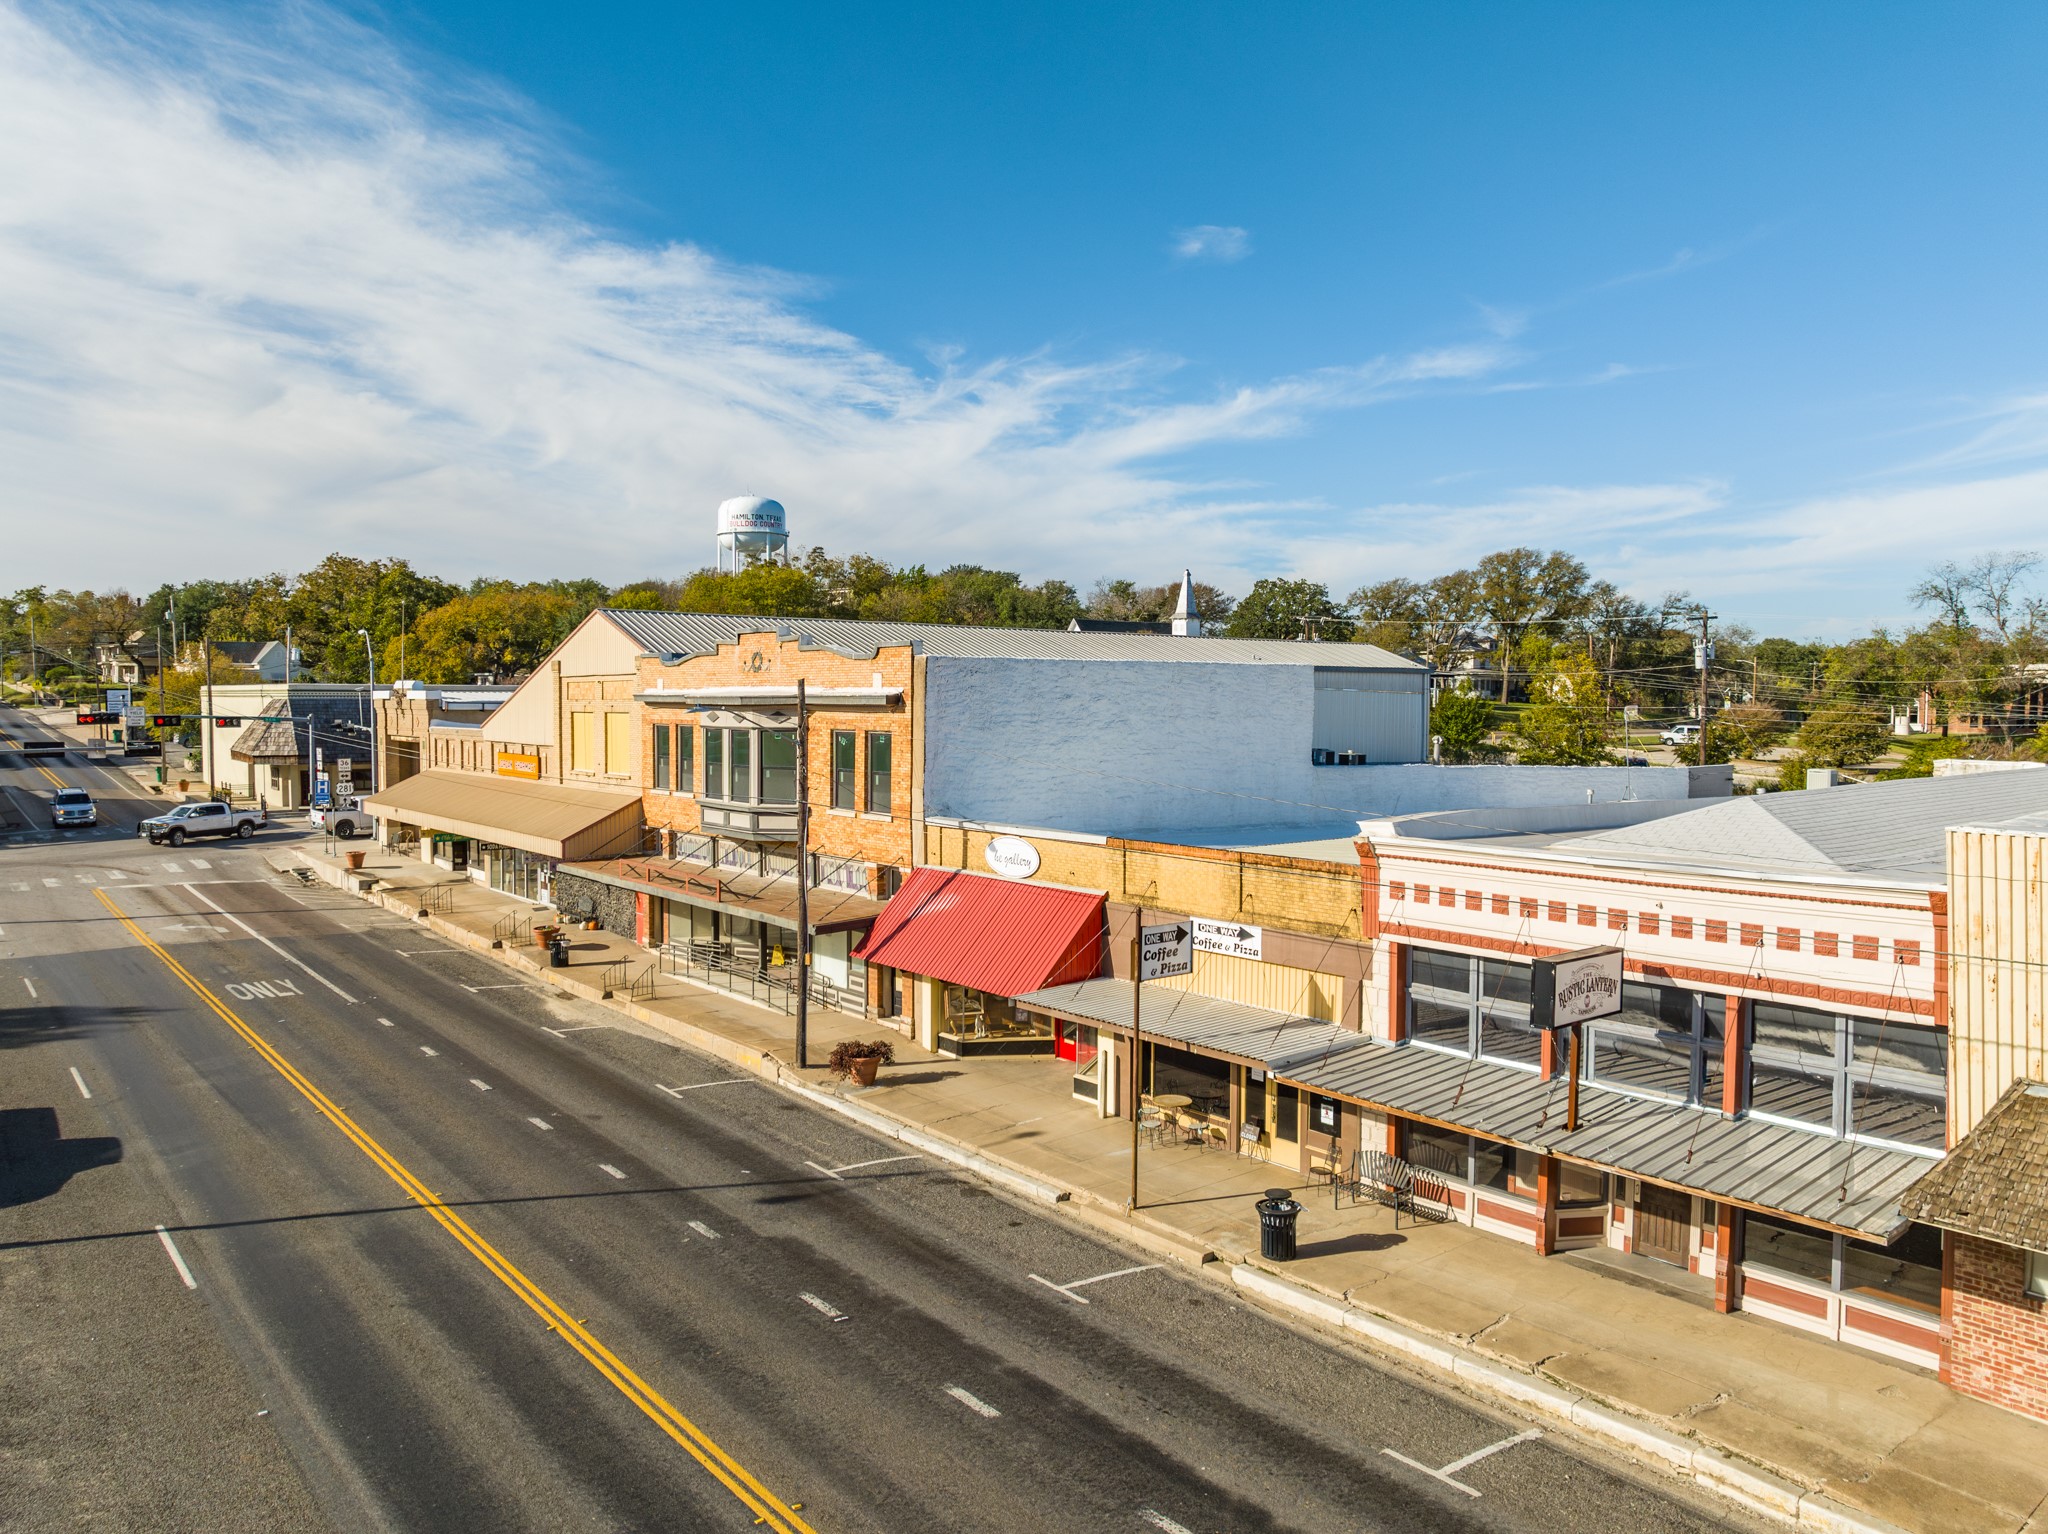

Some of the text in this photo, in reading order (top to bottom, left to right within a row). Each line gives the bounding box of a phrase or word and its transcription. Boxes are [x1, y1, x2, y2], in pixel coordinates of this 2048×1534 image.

[759, 521, 783, 529] COUNTRY
[766, 514, 782, 522] TEXAS
[317, 782, 328, 793] H
[338, 784, 352, 793] 281
[1004, 853, 1031, 870] gallery
[1145, 930, 1178, 945] ONE WAY
[1200, 924, 1238, 937] ONE WAY
[1192, 936, 1223, 950] Coffee
[1233, 943, 1259, 956] Pizza
[1143, 947, 1179, 962] Coffee
[1150, 961, 1188, 976] & Pizza
[224, 978, 305, 1001] ONLY
[1557, 976, 1619, 1010] RUSTIC LANTERN
